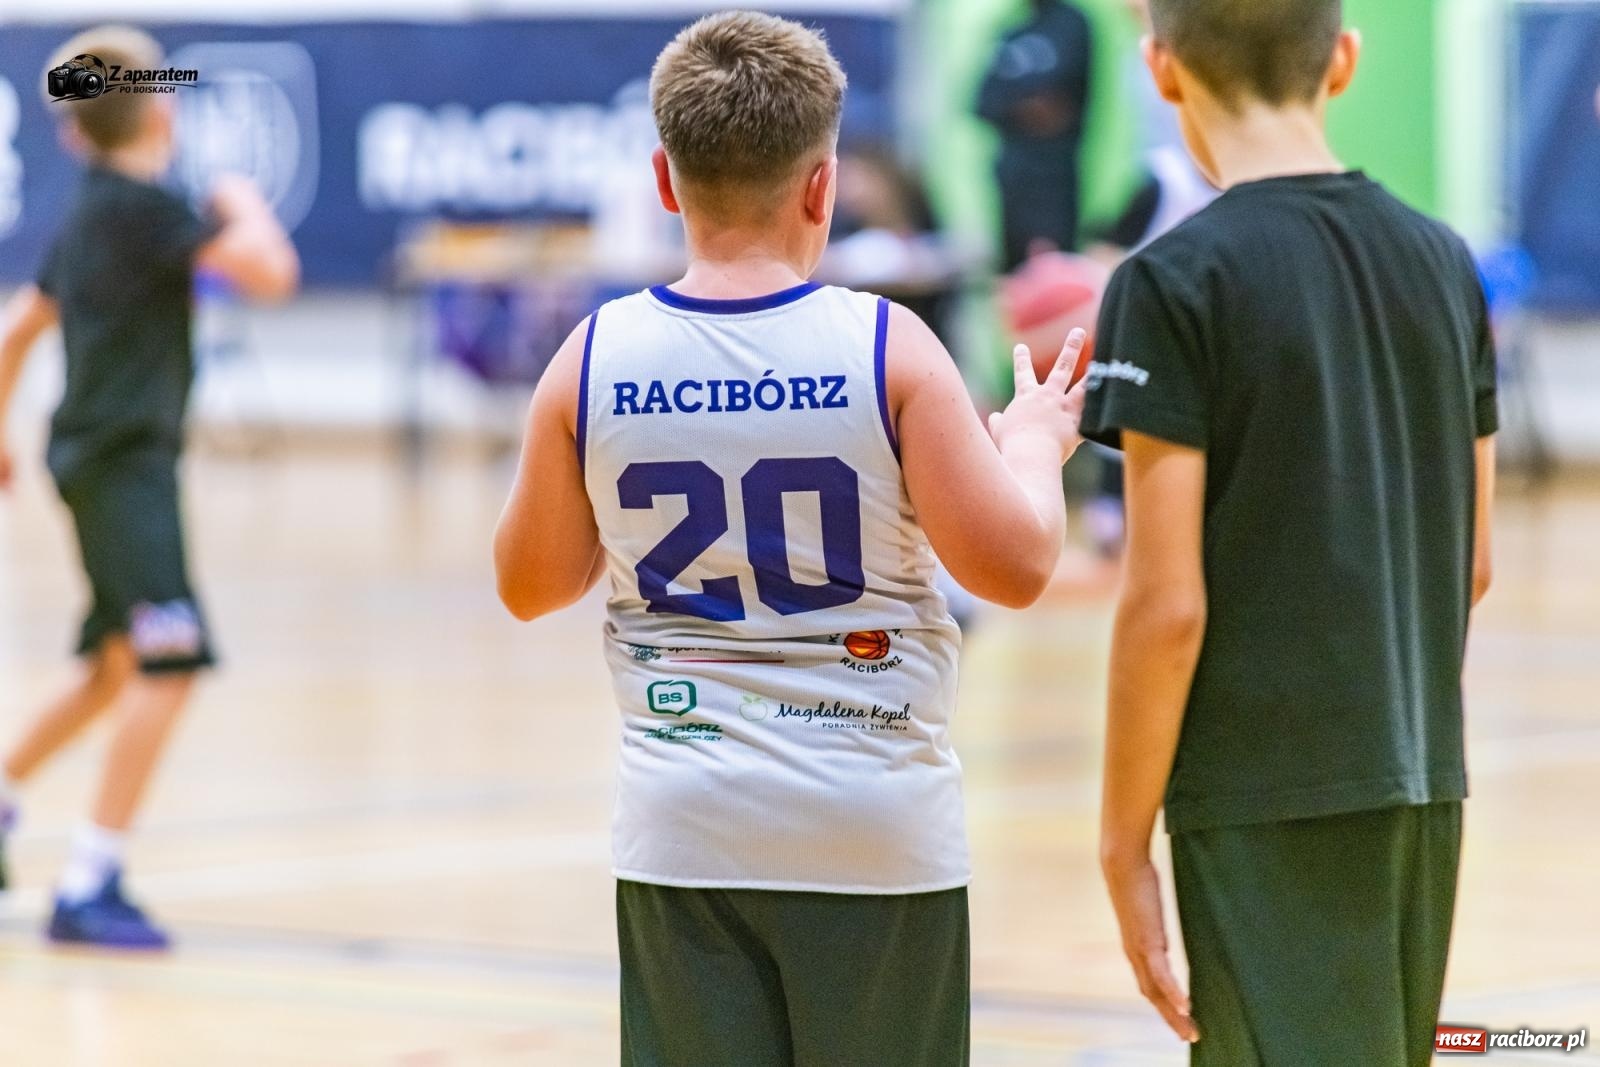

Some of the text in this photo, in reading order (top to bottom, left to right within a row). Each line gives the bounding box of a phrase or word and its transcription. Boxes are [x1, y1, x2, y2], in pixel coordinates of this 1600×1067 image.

[613, 369, 849, 415] RACIBÓRZ
[616, 456, 865, 622] 20
[839, 655, 904, 674] RACIBÓRZ
[658, 692, 683, 705] BS
[774, 701, 911, 724] Magdalena Kopel
